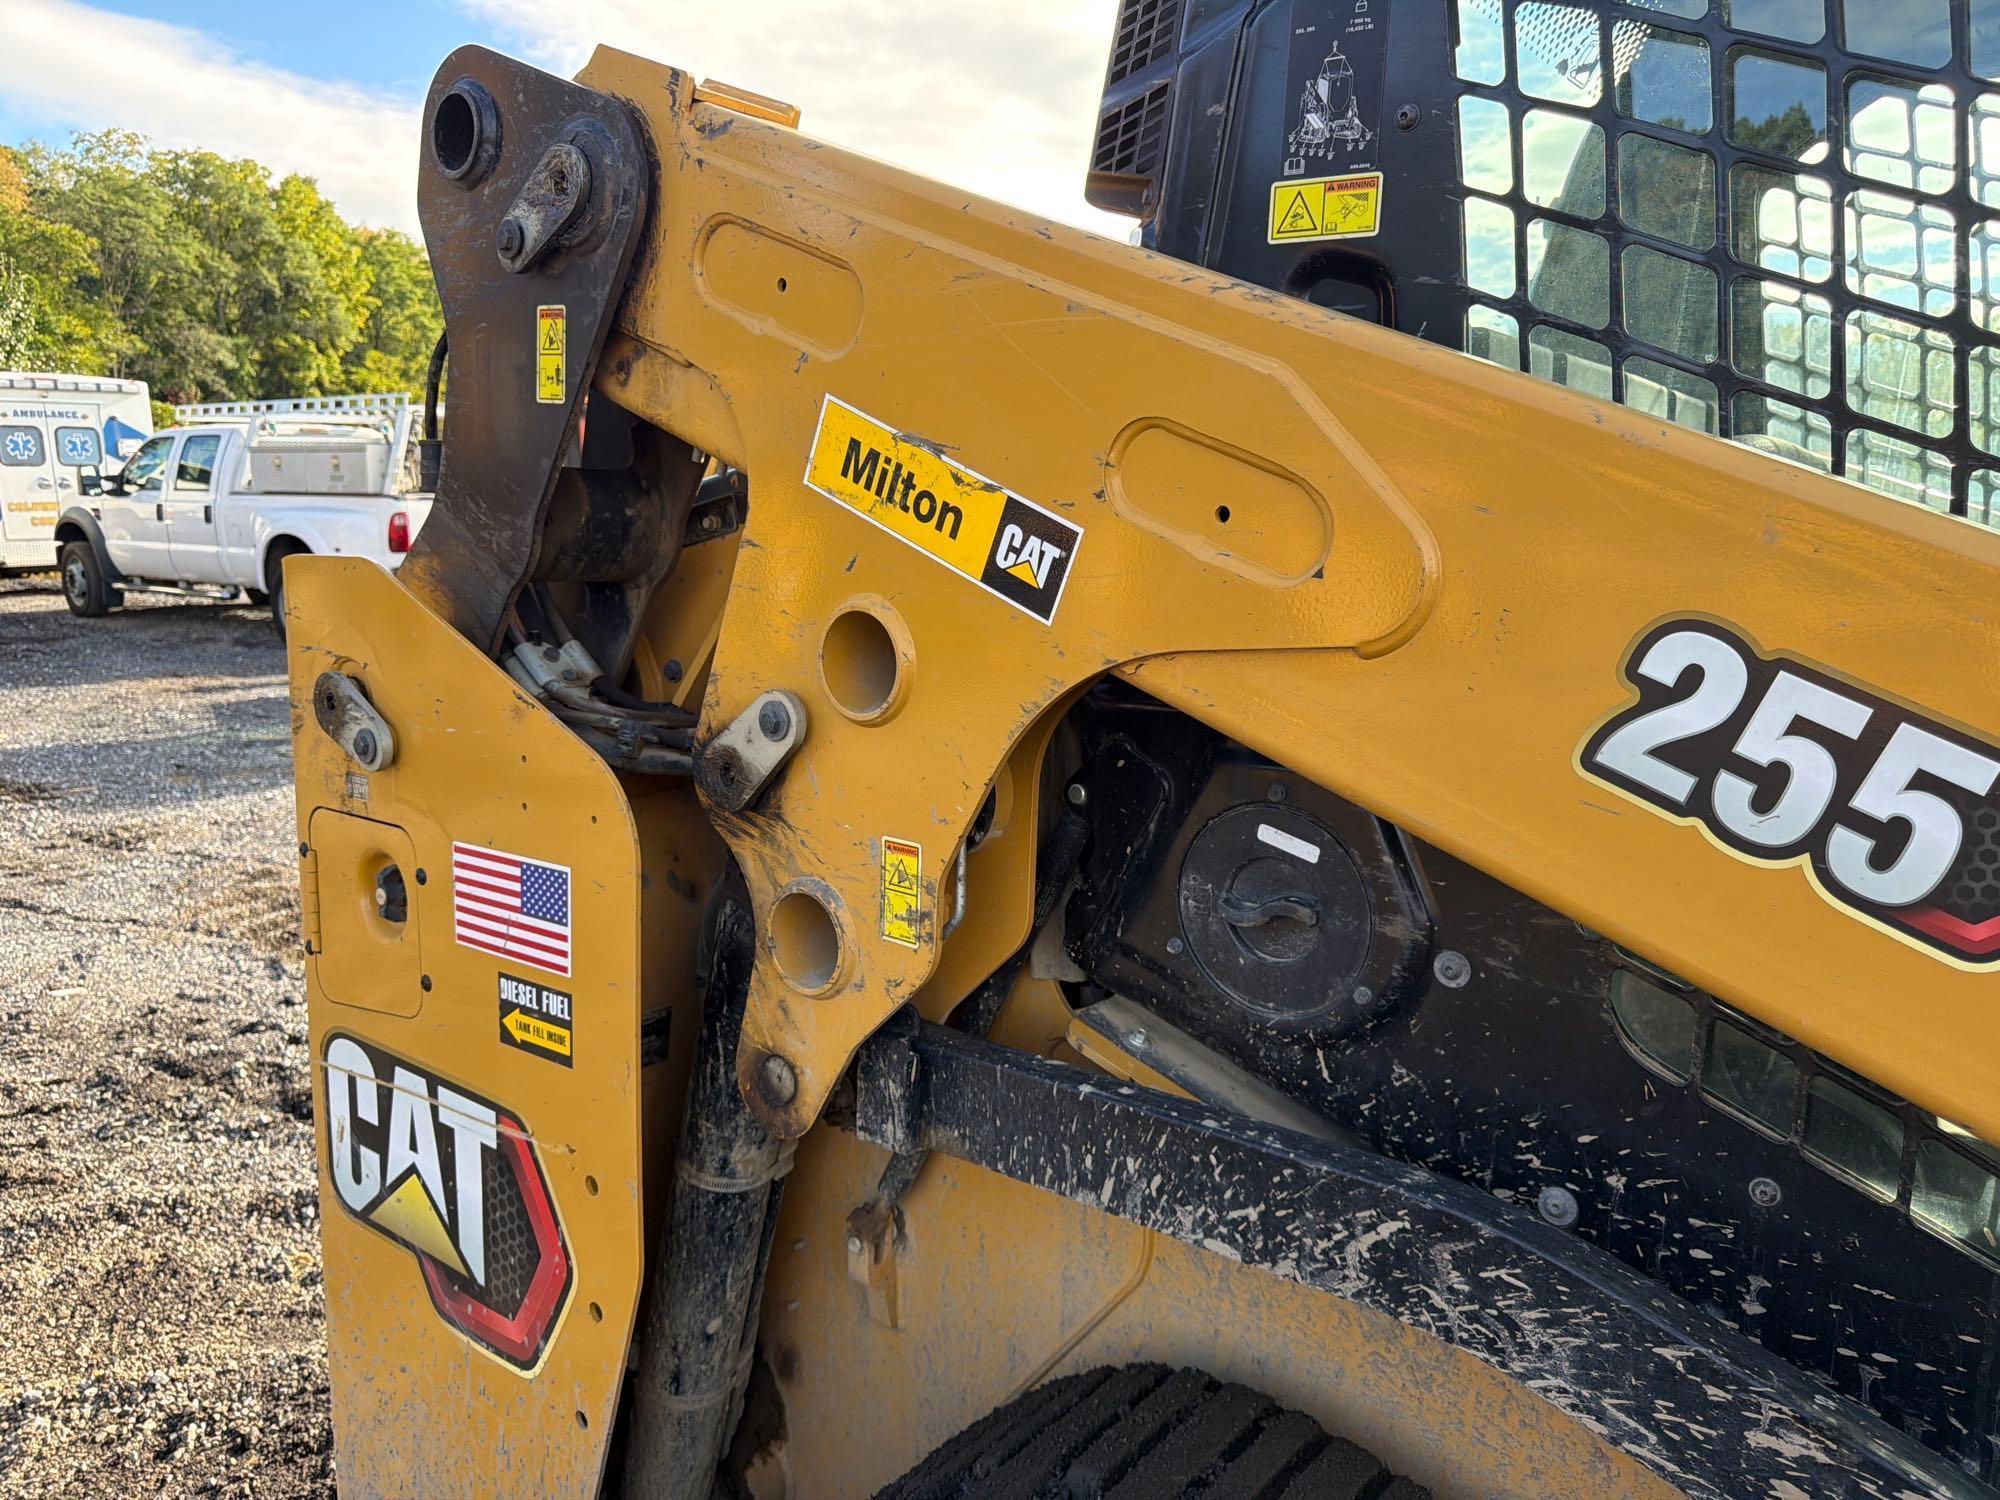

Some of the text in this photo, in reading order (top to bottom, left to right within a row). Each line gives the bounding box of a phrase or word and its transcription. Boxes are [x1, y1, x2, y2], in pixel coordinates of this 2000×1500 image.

[1336, 179, 1376, 191] WARNING
[12, 409, 79, 420] AMBULANCE
[840, 435, 964, 542] Milton
[995, 522, 1062, 590] CAT
[1591, 629, 2000, 908] 255
[892, 845, 918, 857] WARNING
[499, 976, 571, 1022] DIESEL FUEL
[514, 1019, 568, 1048] TANK FILL INSIDE
[326, 1036, 498, 1288] CAT
